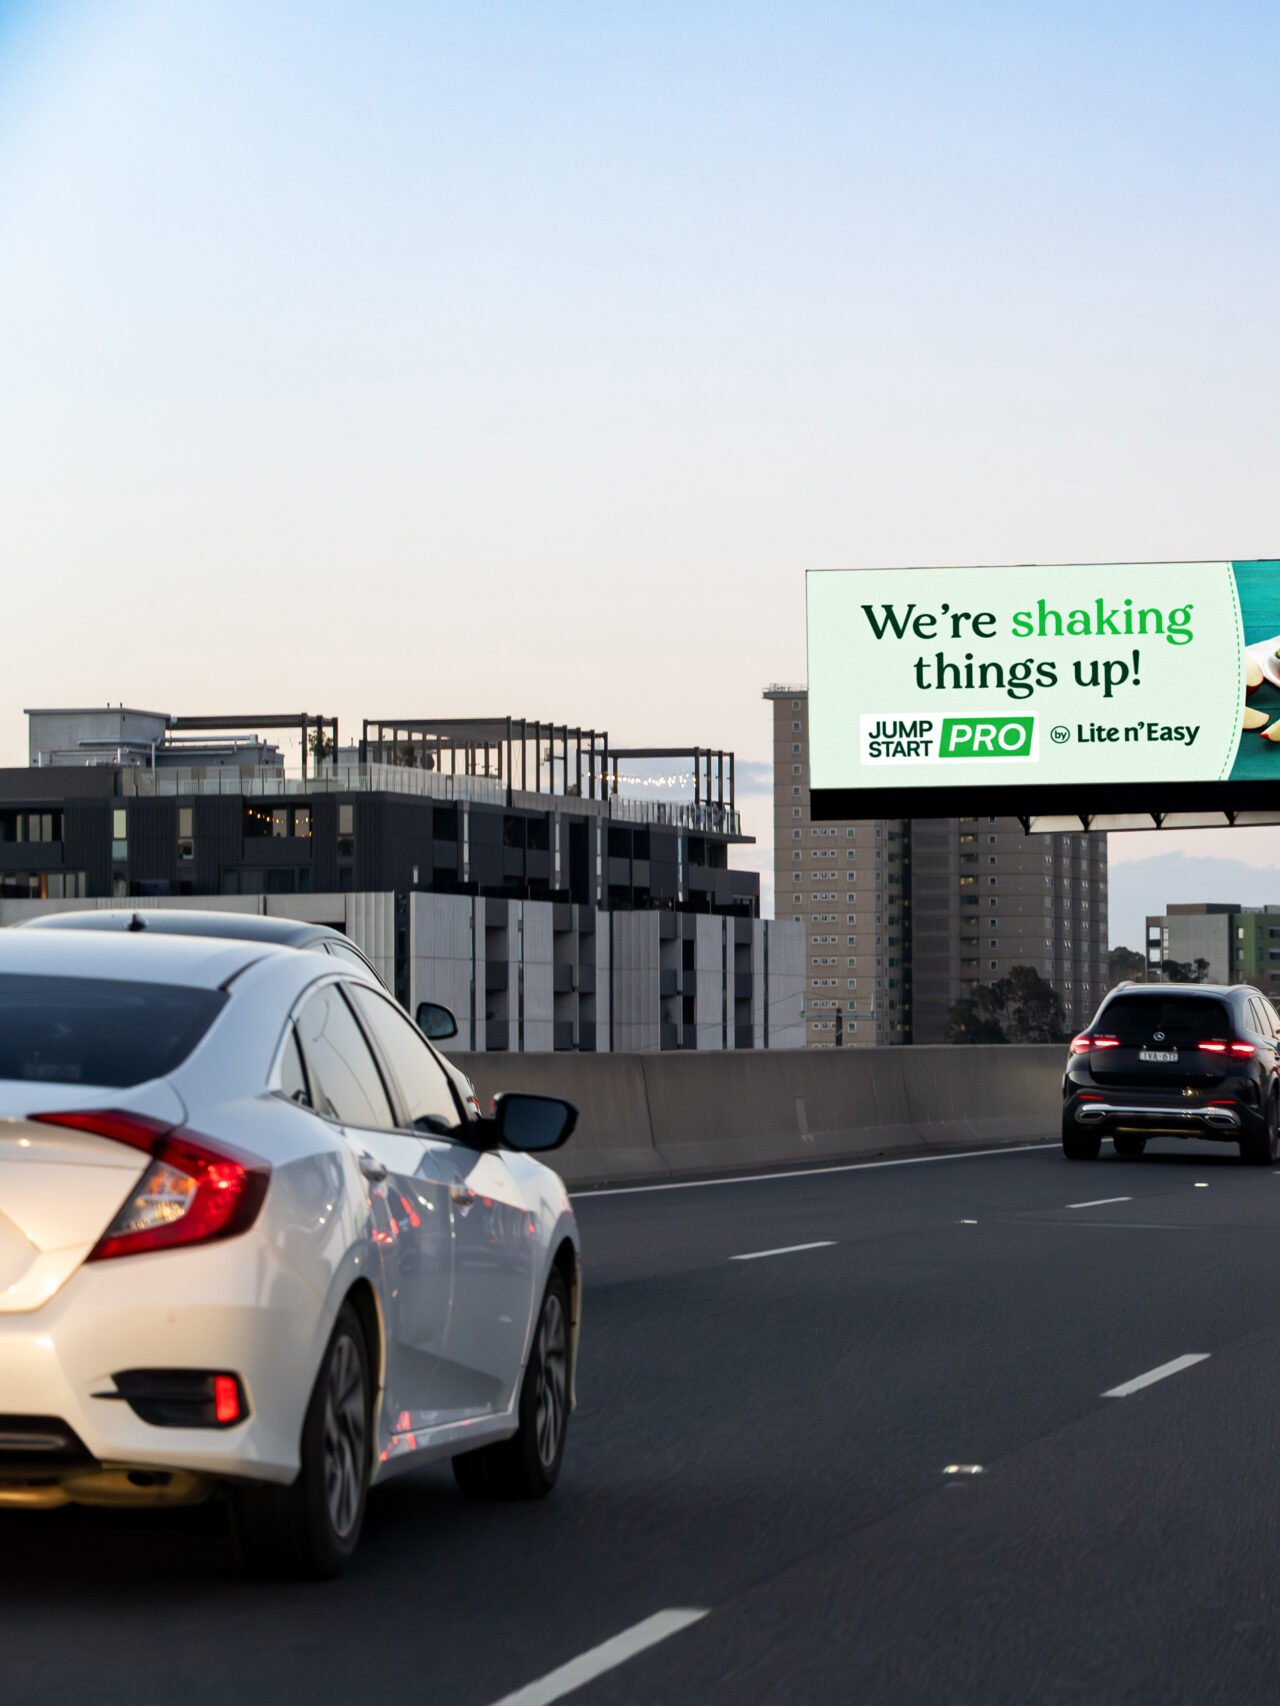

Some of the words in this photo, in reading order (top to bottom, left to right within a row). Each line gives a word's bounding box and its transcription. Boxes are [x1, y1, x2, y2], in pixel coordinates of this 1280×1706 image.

[861, 603, 997, 640] We're
[1011, 597, 1194, 645] shaking
[913, 652, 1058, 700] things
[1072, 649, 1141, 698] up!
[868, 720, 933, 739] JUMP
[949, 723, 1027, 751] PRO
[1077, 722, 1120, 742] Lite
[869, 740, 933, 758] START
